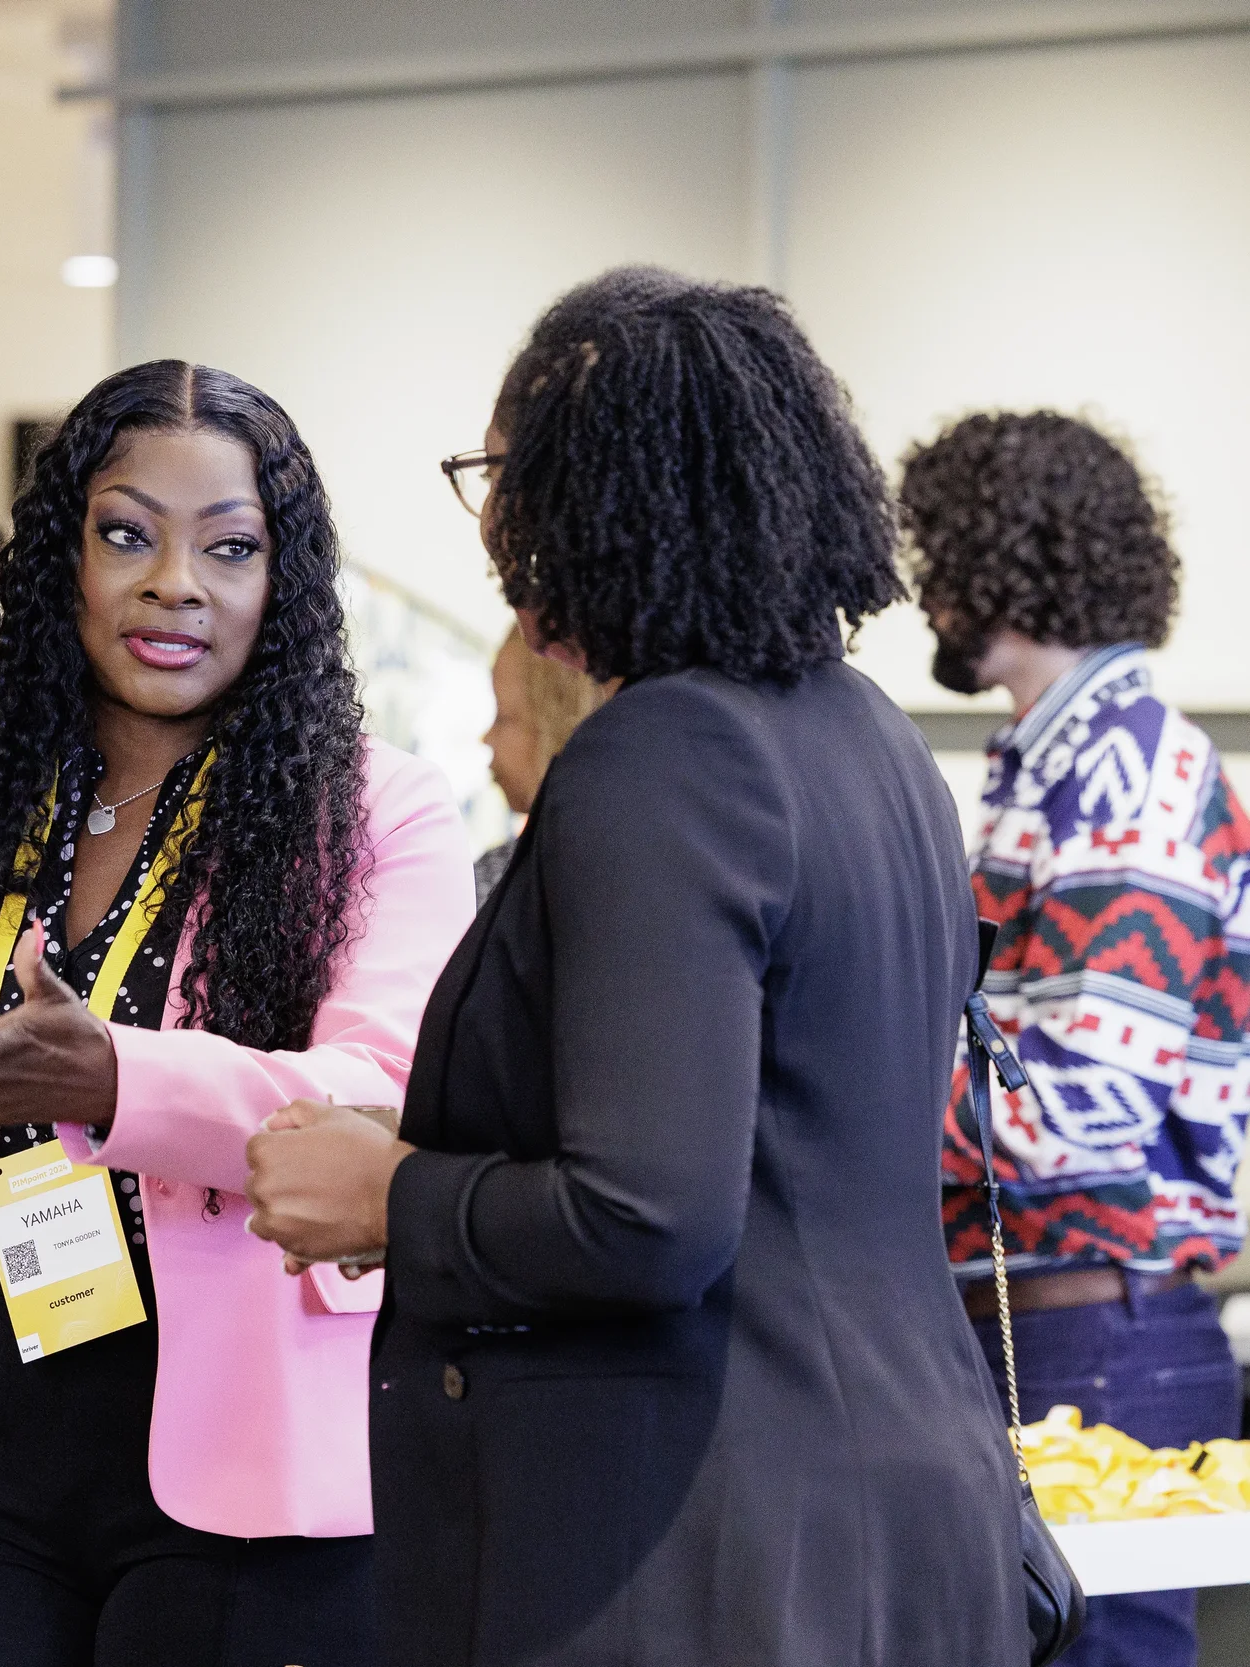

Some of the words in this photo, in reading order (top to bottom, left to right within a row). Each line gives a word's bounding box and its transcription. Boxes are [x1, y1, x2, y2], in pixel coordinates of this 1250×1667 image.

[11, 1170, 48, 1189] PIMpoint
[49, 1163, 68, 1177] 2024
[21, 1198, 83, 1228] YAMAHA
[53, 1238, 74, 1250] TONYA
[74, 1229, 101, 1245] GOODEN
[49, 1286, 95, 1310] customer
[21, 1343, 39, 1354] inriver
